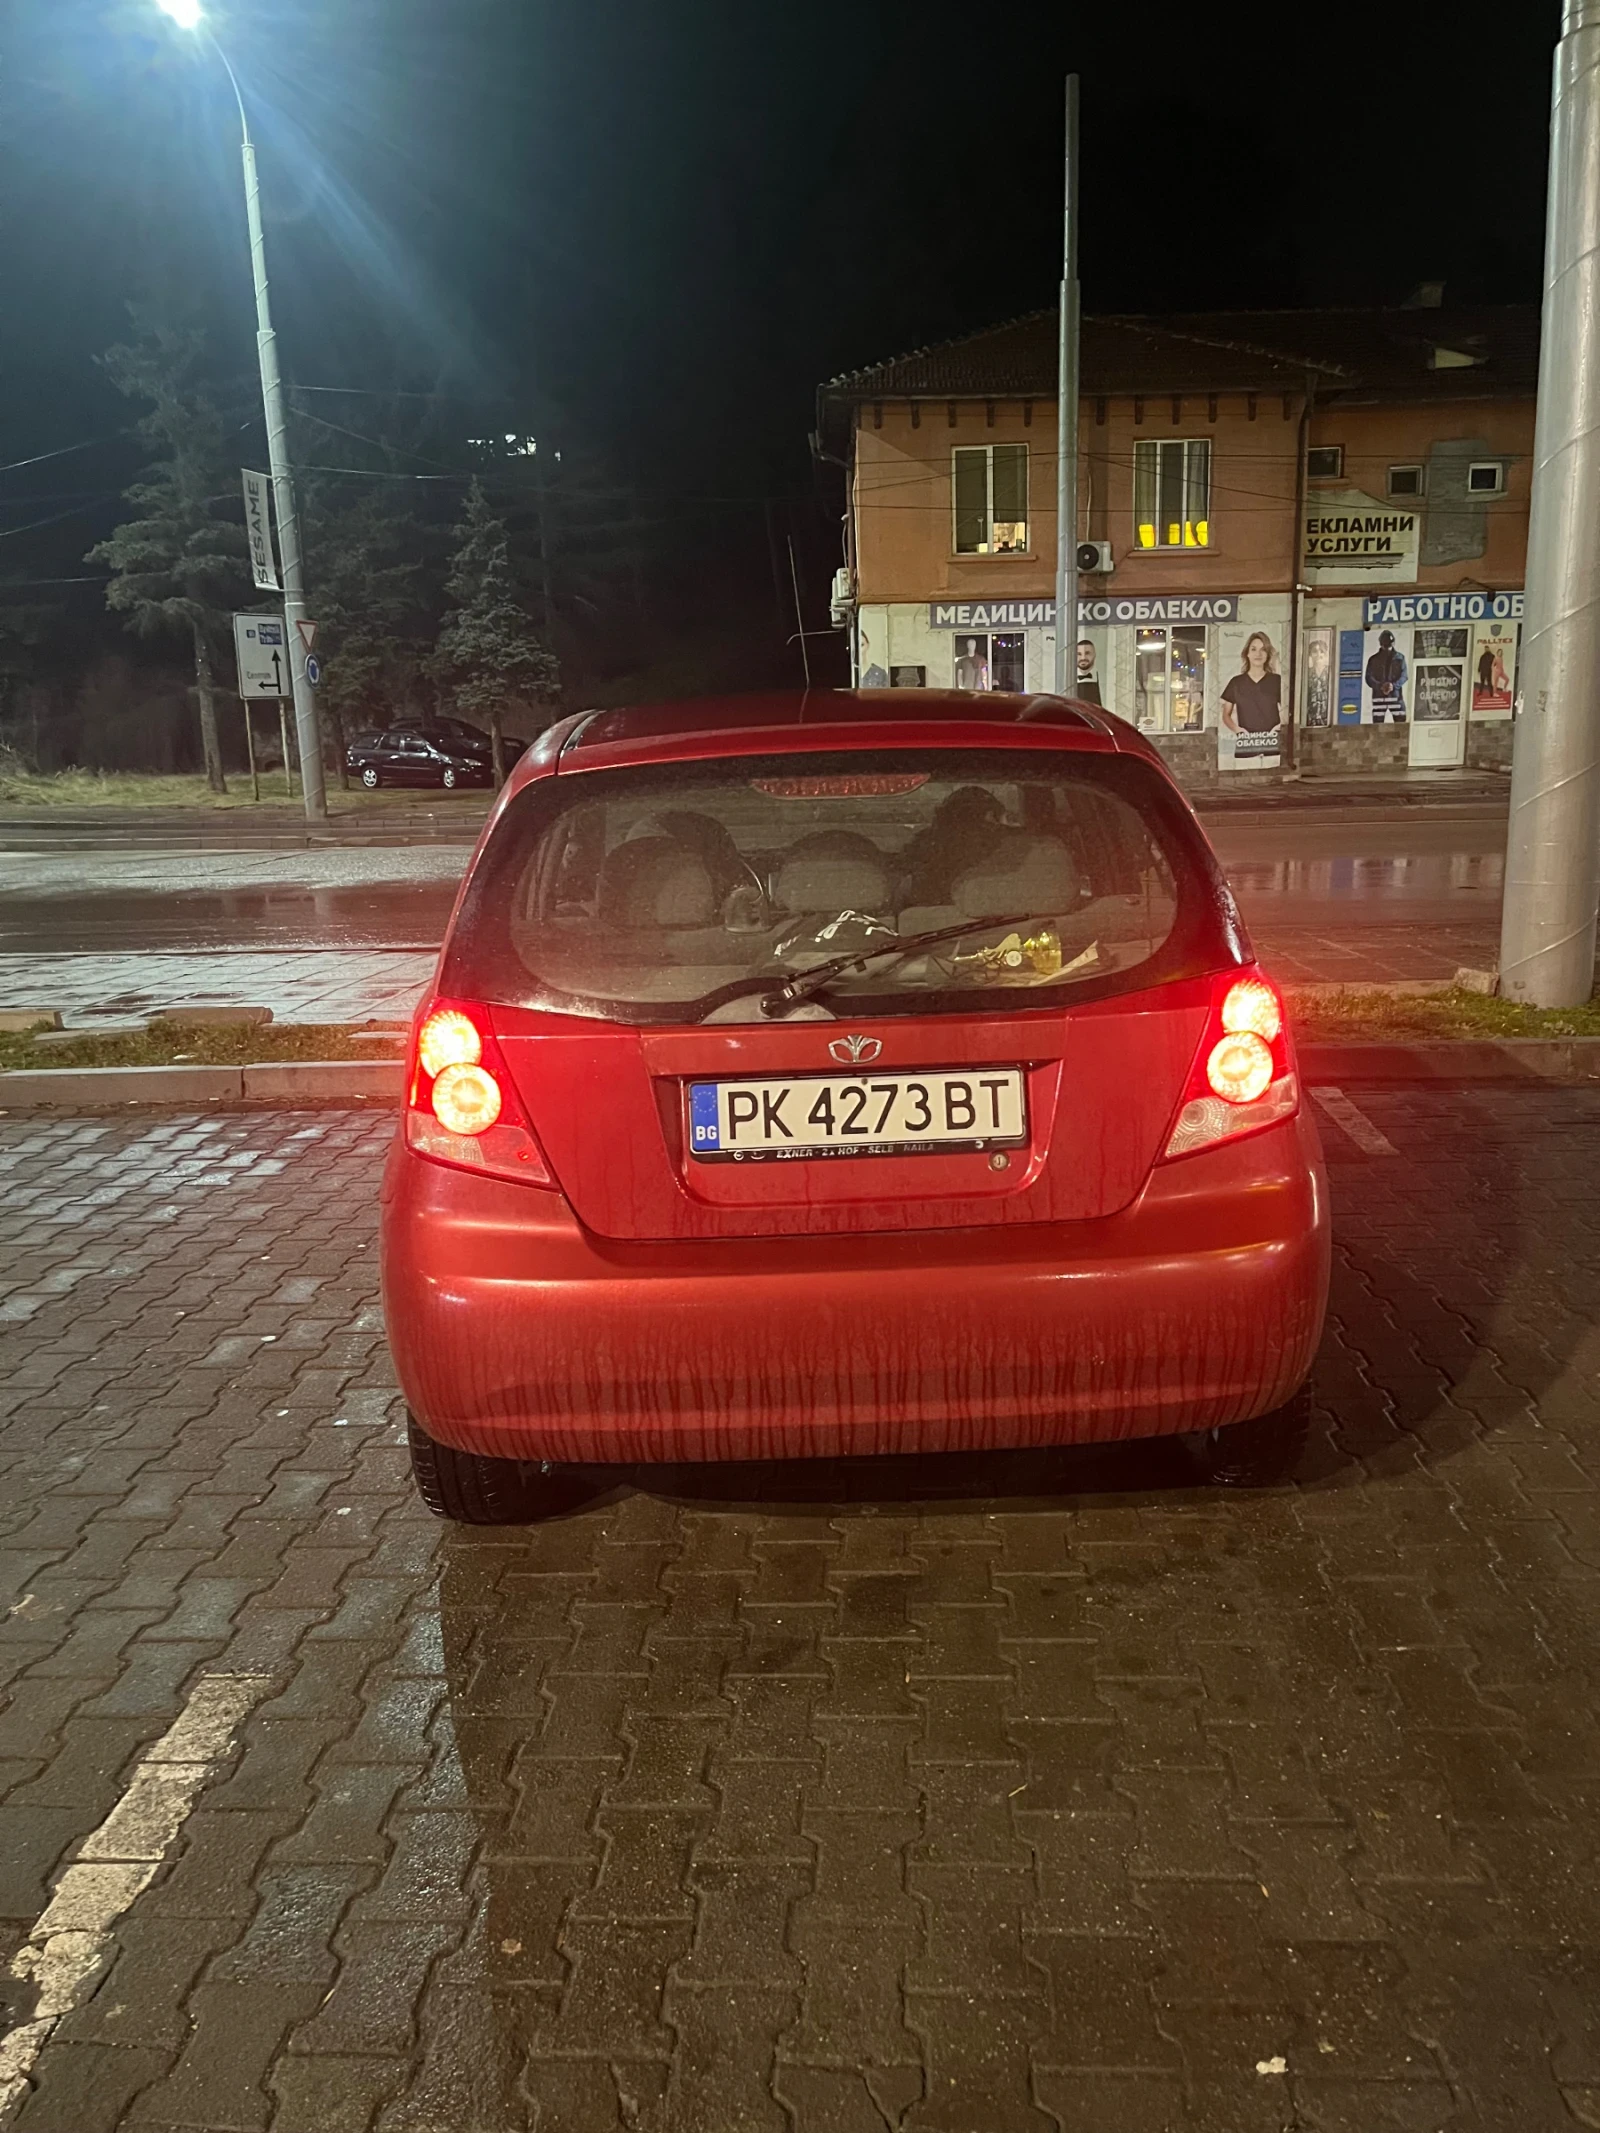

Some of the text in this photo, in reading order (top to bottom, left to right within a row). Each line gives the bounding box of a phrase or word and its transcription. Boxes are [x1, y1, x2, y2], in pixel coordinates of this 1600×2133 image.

[247, 479, 269, 583] SESAME
[1306, 516, 1414, 534] ЕКЛАМНИ
[1307, 537, 1391, 553] УСЛУГИ
[936, 600, 1232, 626] МЕДИЦИНКО ОБЛЕКЛО
[1367, 595, 1525, 622] РАБОТНО ОБ
[1236, 738, 1278, 747] ОБЛЕКЛО
[727, 1079, 1010, 1140] PK 4273 BT
[695, 1125, 718, 1142] BG
